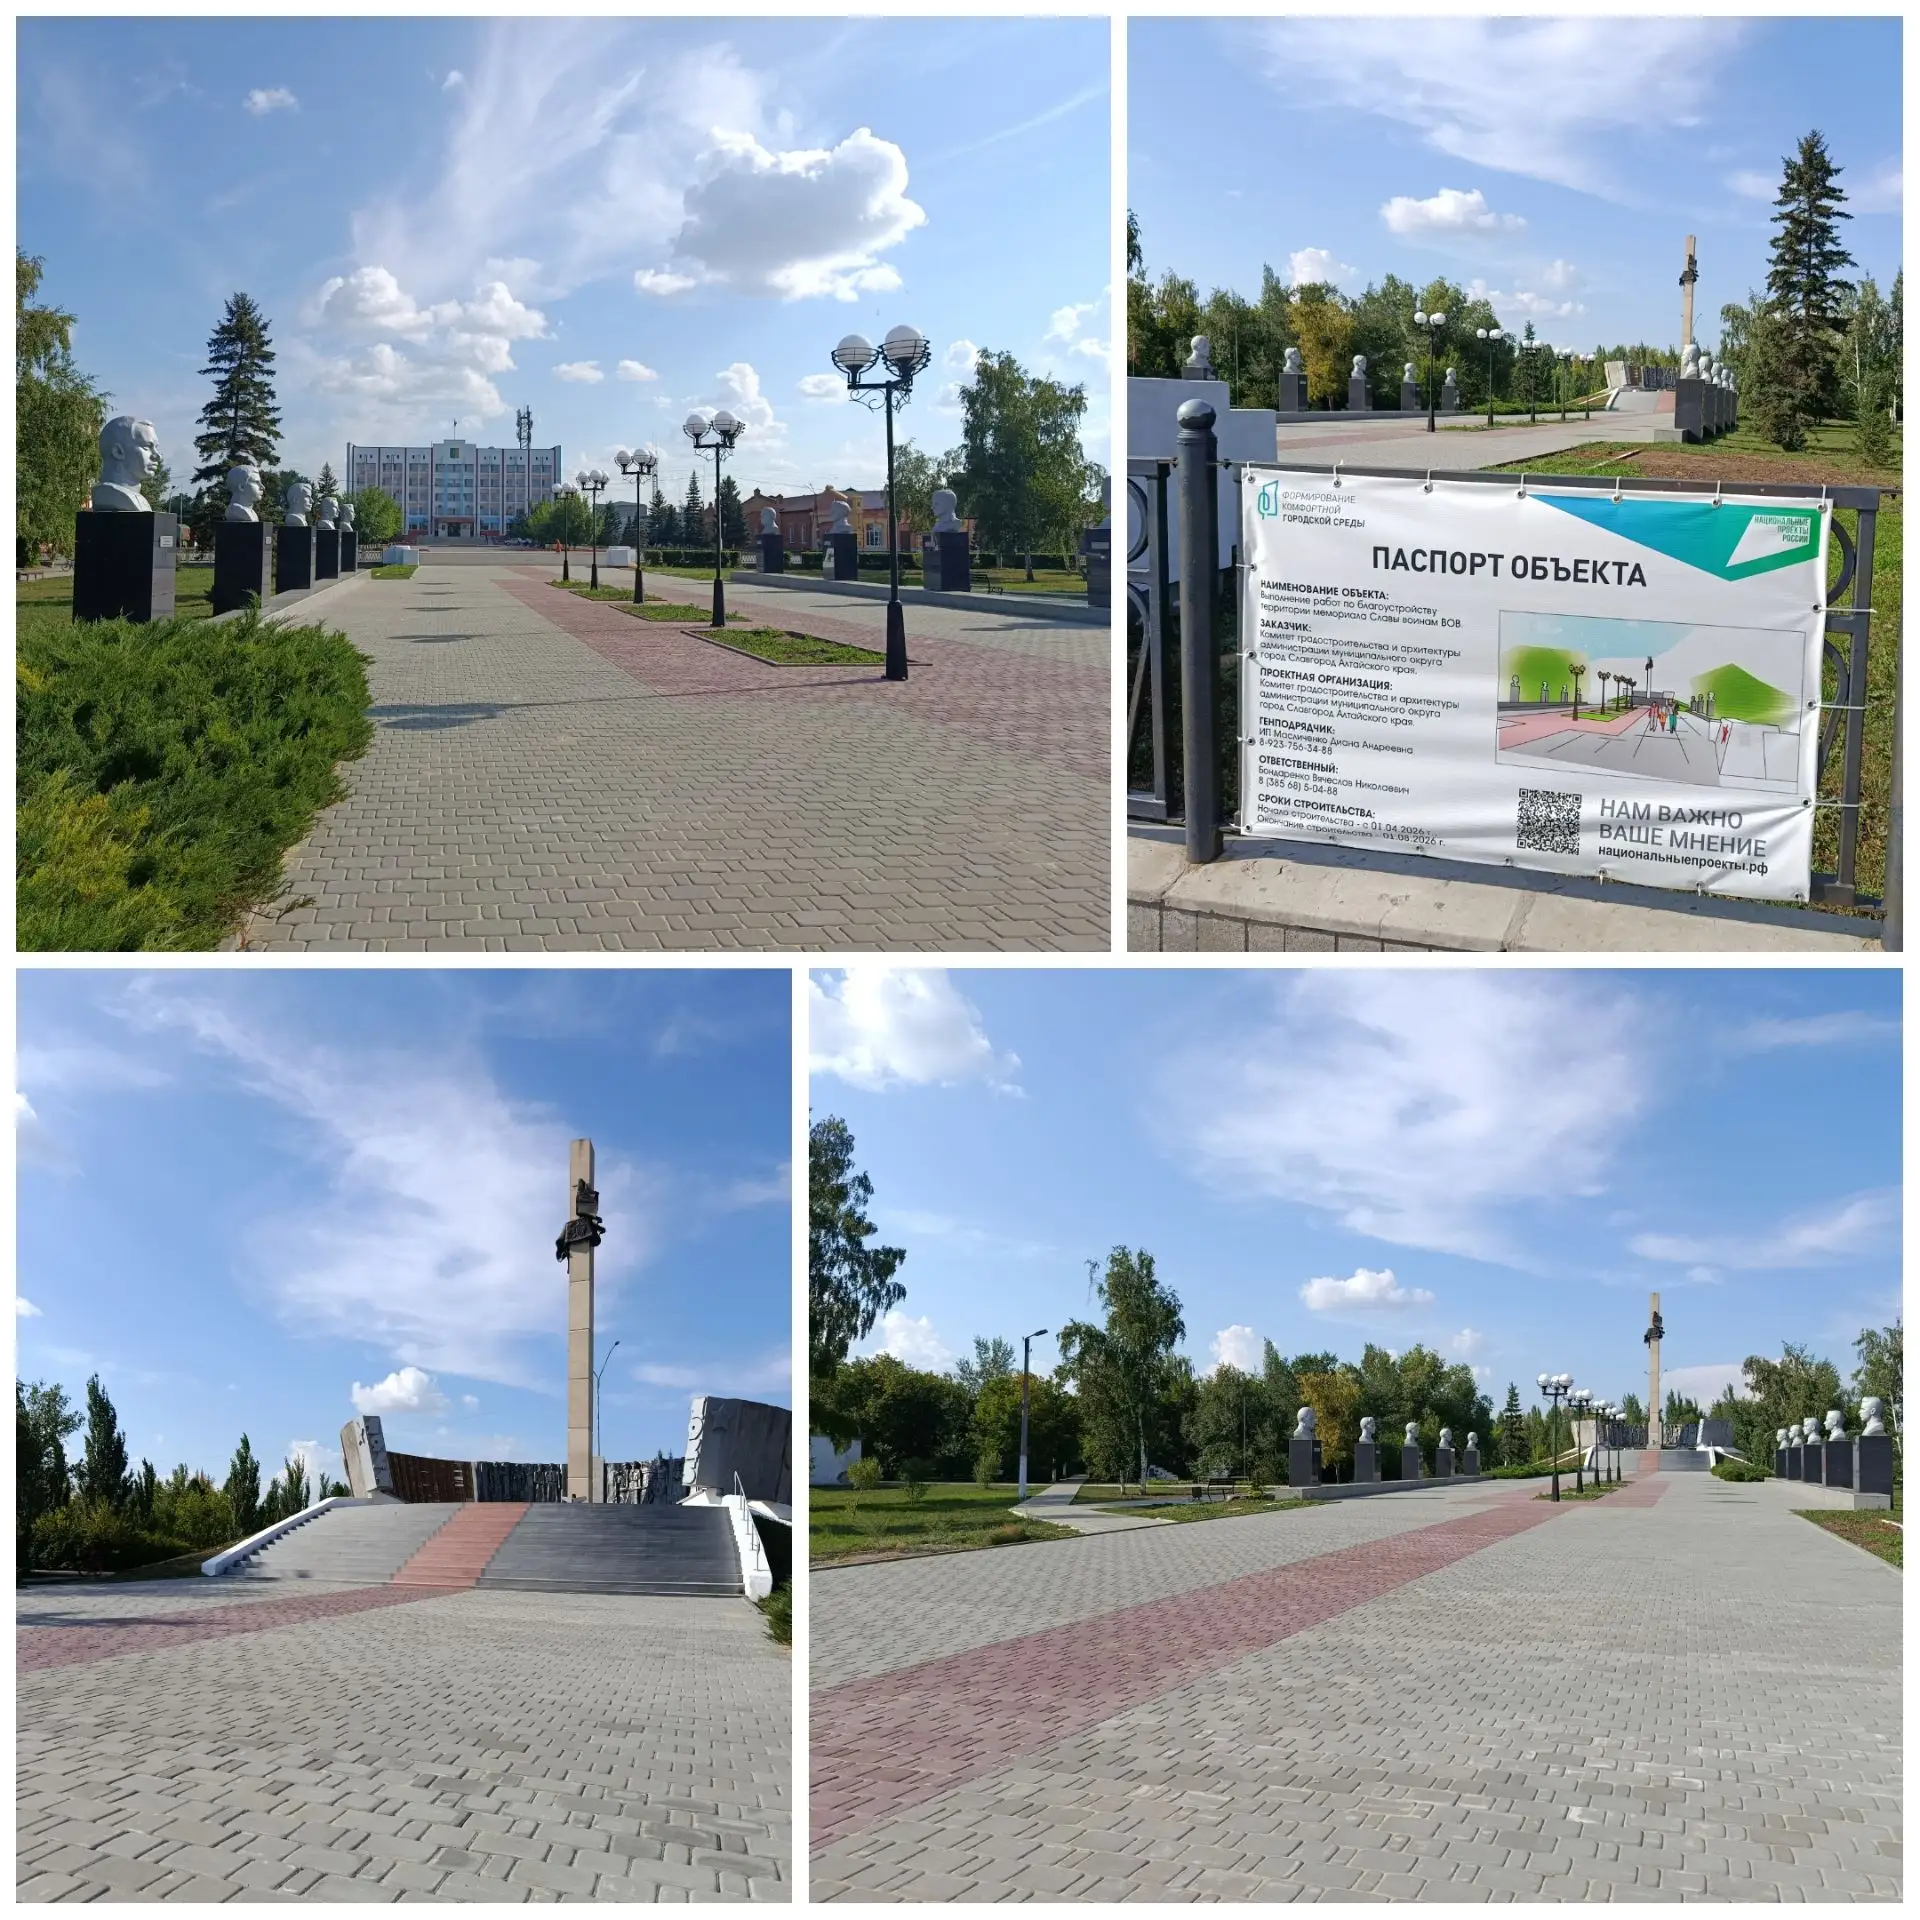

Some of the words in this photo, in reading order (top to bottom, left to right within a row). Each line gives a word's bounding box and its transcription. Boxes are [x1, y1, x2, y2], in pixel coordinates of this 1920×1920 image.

[1282, 491, 1356, 504] ФОРМИРОВАНИЕ
[1282, 502, 1341, 514] КОМФОРТНОЙ
[1283, 514, 1331, 526] ГОРОДСКОЙ
[1333, 518, 1365, 528] СРЕДЫ
[1754, 515, 1809, 527] НАЦИОНАЛЬНЫЕ
[1778, 525, 1809, 535] ПРОЕКТЫ
[1782, 534, 1808, 543] РОССИИ
[1372, 546, 1504, 577] ПАСПОРТ
[1511, 554, 1647, 587] ОБЪЕКТА
[1260, 579, 1339, 596] НАИМЕНОВАНИЕ
[1341, 587, 1389, 600] ОБЪЕКТА:
[1260, 590, 1311, 605] Выполнение
[1313, 597, 1340, 607] работ
[1343, 600, 1355, 608] по
[1357, 600, 1438, 617] благоустройству
[1260, 603, 1311, 615] территории
[1313, 608, 1367, 620] мемориала
[1369, 612, 1399, 623] Славы
[1402, 616, 1438, 626] воинам
[1260, 618, 1312, 632] ЗАКАЗЧИК:
[1260, 629, 1295, 641] Комитет
[1297, 635, 1389, 650] градостроительства
[1392, 644, 1398, 652] и
[1400, 645, 1461, 659] архитектуры
[1260, 641, 1329, 655] администрации
[1331, 648, 1407, 662] муниципального
[1409, 656, 1443, 667] округа
[1260, 651, 1286, 662] город
[1288, 653, 1336, 667] Славгород
[1338, 659, 1390, 672] Алтайского
[1392, 665, 1417, 675] края.
[1260, 667, 1315, 682] ПРОЕКТНАЯ
[1318, 674, 1393, 691] ОРГАНИЗАЦИЯ:
[1260, 678, 1295, 690] Комитет
[1297, 684, 1388, 701] градостроительства
[1399, 696, 1460, 710] архитектуры
[1260, 691, 1329, 705] администрации
[1330, 699, 1405, 714] муниципального
[1408, 708, 1441, 719] округа
[1259, 716, 1335, 735] ГЕНПОДРЯДЧИК:
[1260, 701, 1285, 711] город
[1287, 703, 1334, 718] Славгород
[1336, 709, 1388, 723] Алтайского
[1390, 717, 1415, 727] края.
[1259, 727, 1271, 737] ИП
[1273, 729, 1328, 744] Масличенко
[1330, 737, 1360, 748] Диана
[1362, 740, 1414, 755] Андреевна
[1259, 737, 1333, 755] 8-923-756-34-88
[1259, 755, 1339, 774] ОТВЕТСТВЕННЫЙ:
[1259, 765, 1310, 780] Бондаренко
[1312, 773, 1353, 787] Вячеслав
[1355, 779, 1410, 794] Николаевич
[1259, 776, 1264, 785] 8
[1304, 783, 1338, 796] 5-04-88
[1258, 793, 1291, 806] СРОКИ
[1293, 799, 1376, 819] СТРОИТЕЛЬСТВА:
[1600, 798, 1651, 821] НАМ
[1658, 805, 1743, 829] ВАЖНО
[1257, 814, 1304, 830] Окончание
[1306, 824, 1373, 838] строительства
[1439, 839, 1446, 847] г.
[1291, 810, 1354, 826] строительства
[1371, 821, 1425, 835] 01.04.2026
[1599, 823, 1664, 846] ВАШЕ
[1669, 829, 1767, 858] МНЕНИЕ
[1598, 845, 1769, 876] национальныепроекты.рф
